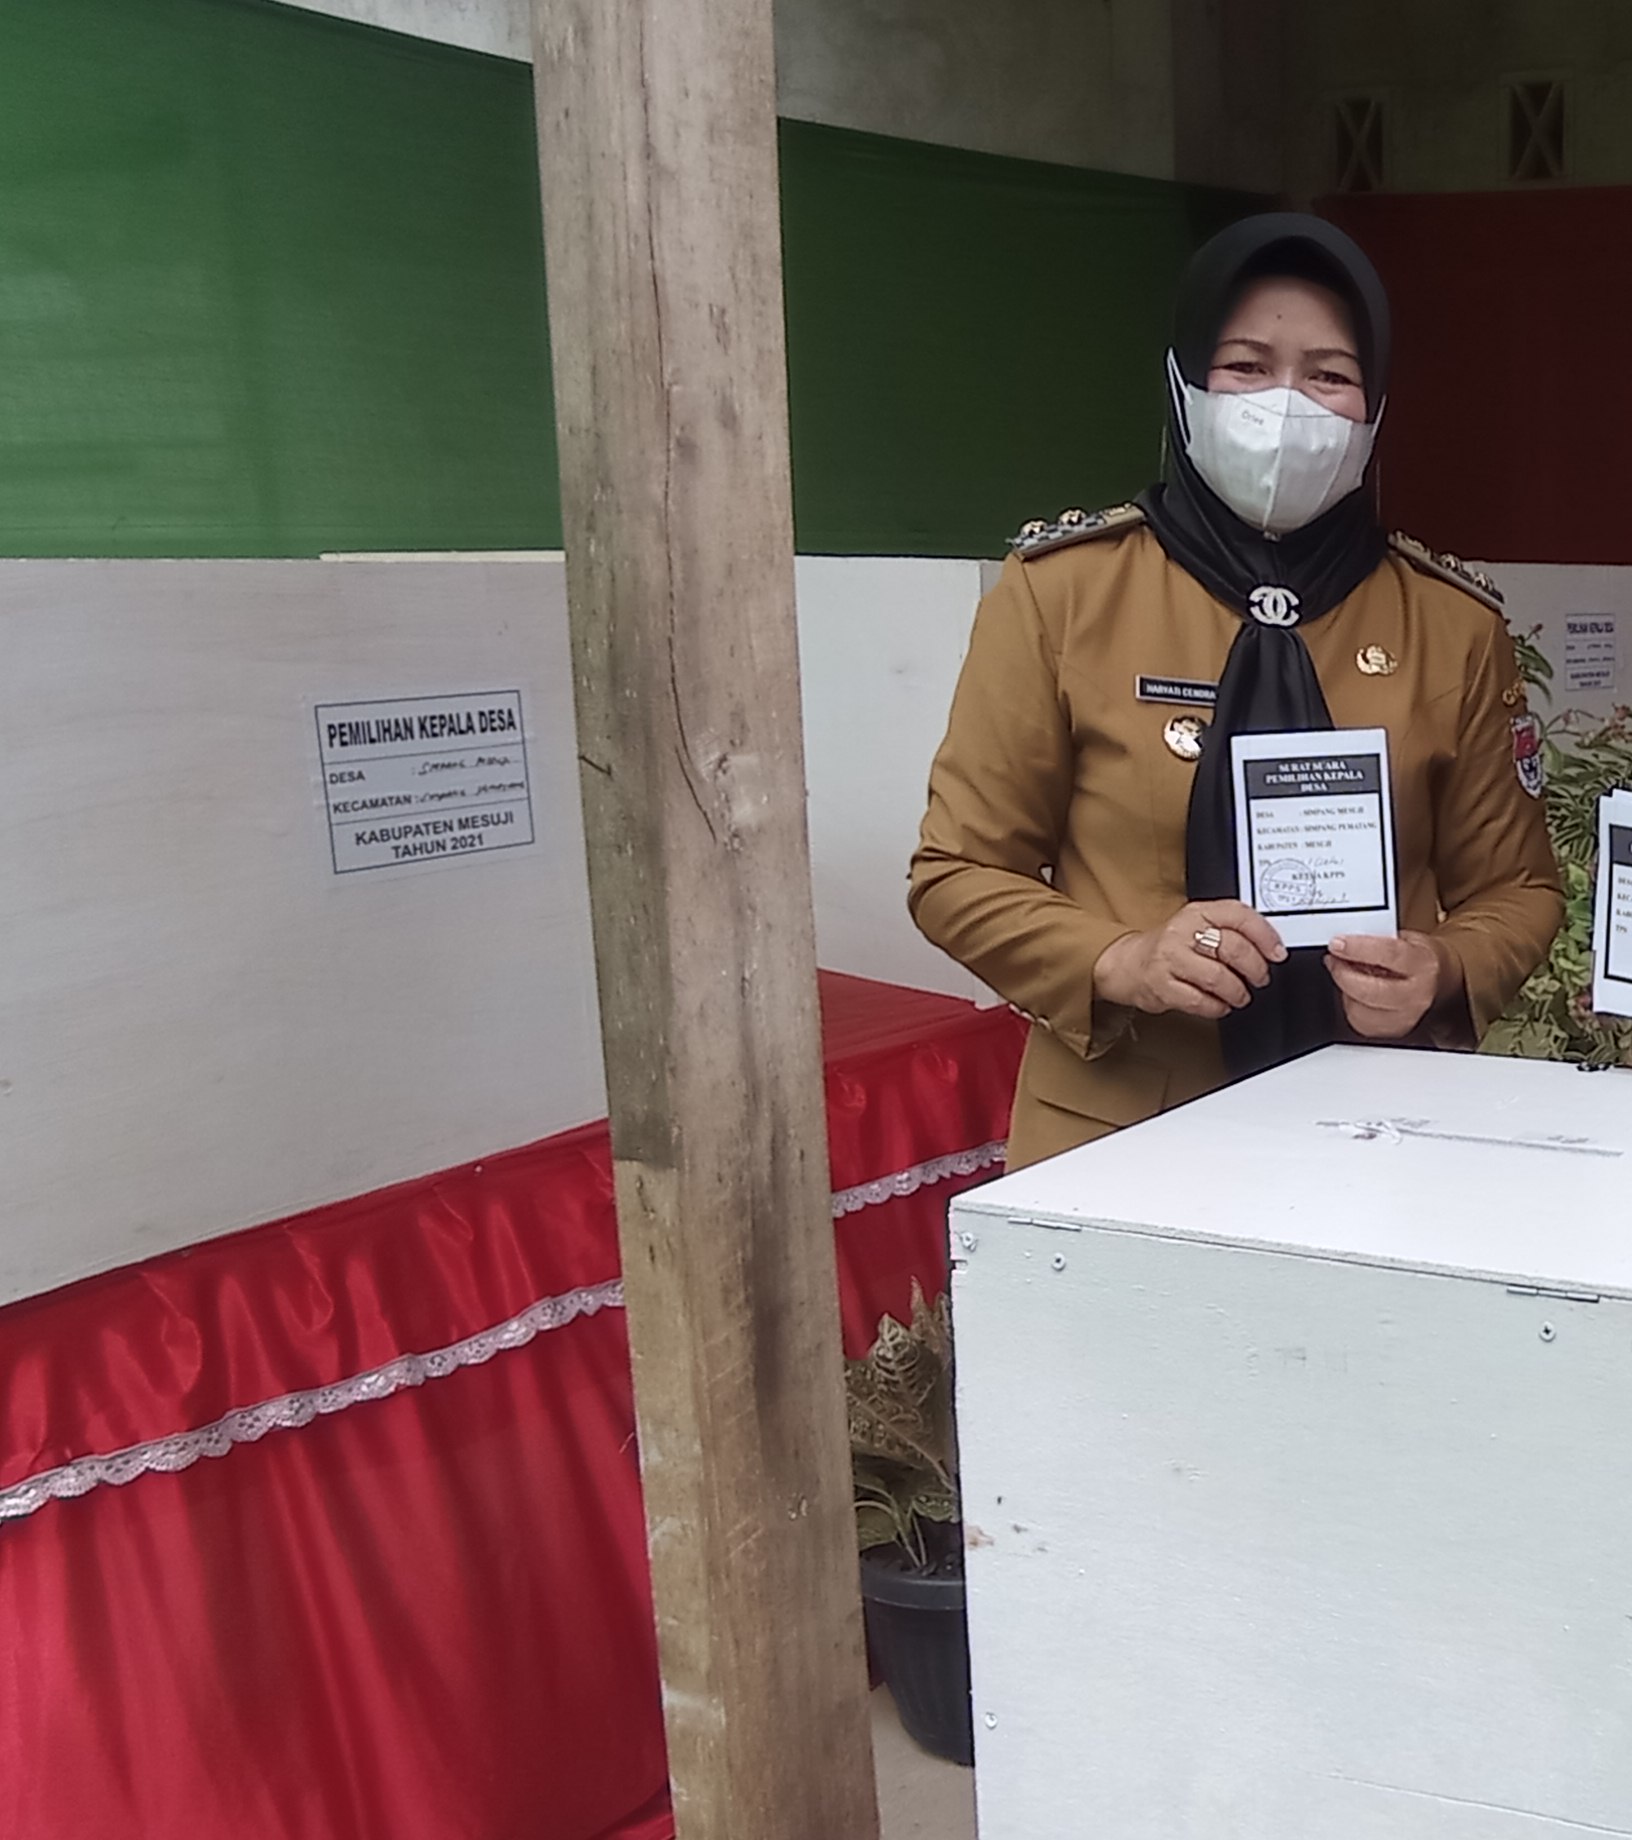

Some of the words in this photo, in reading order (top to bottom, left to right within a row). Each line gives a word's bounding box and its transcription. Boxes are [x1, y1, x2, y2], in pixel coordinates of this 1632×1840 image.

[327, 717, 415, 748] PEMILIHAN
[419, 712, 475, 739] KEPALA
[479, 708, 516, 733] DESA
[1278, 762, 1311, 772] SURAT
[1312, 761, 1346, 770] SUARA
[329, 771, 365, 784] DESA
[1265, 773, 1322, 784] PEMILIHAN
[1323, 770, 1364, 780] KEPALA
[1300, 783, 1328, 792] DESA
[333, 795, 412, 814] KECAMATAN
[355, 821, 454, 845] KABUPATEN
[458, 811, 514, 831] MESUJI
[391, 840, 446, 859] TAHUN
[450, 834, 484, 850] 2021
